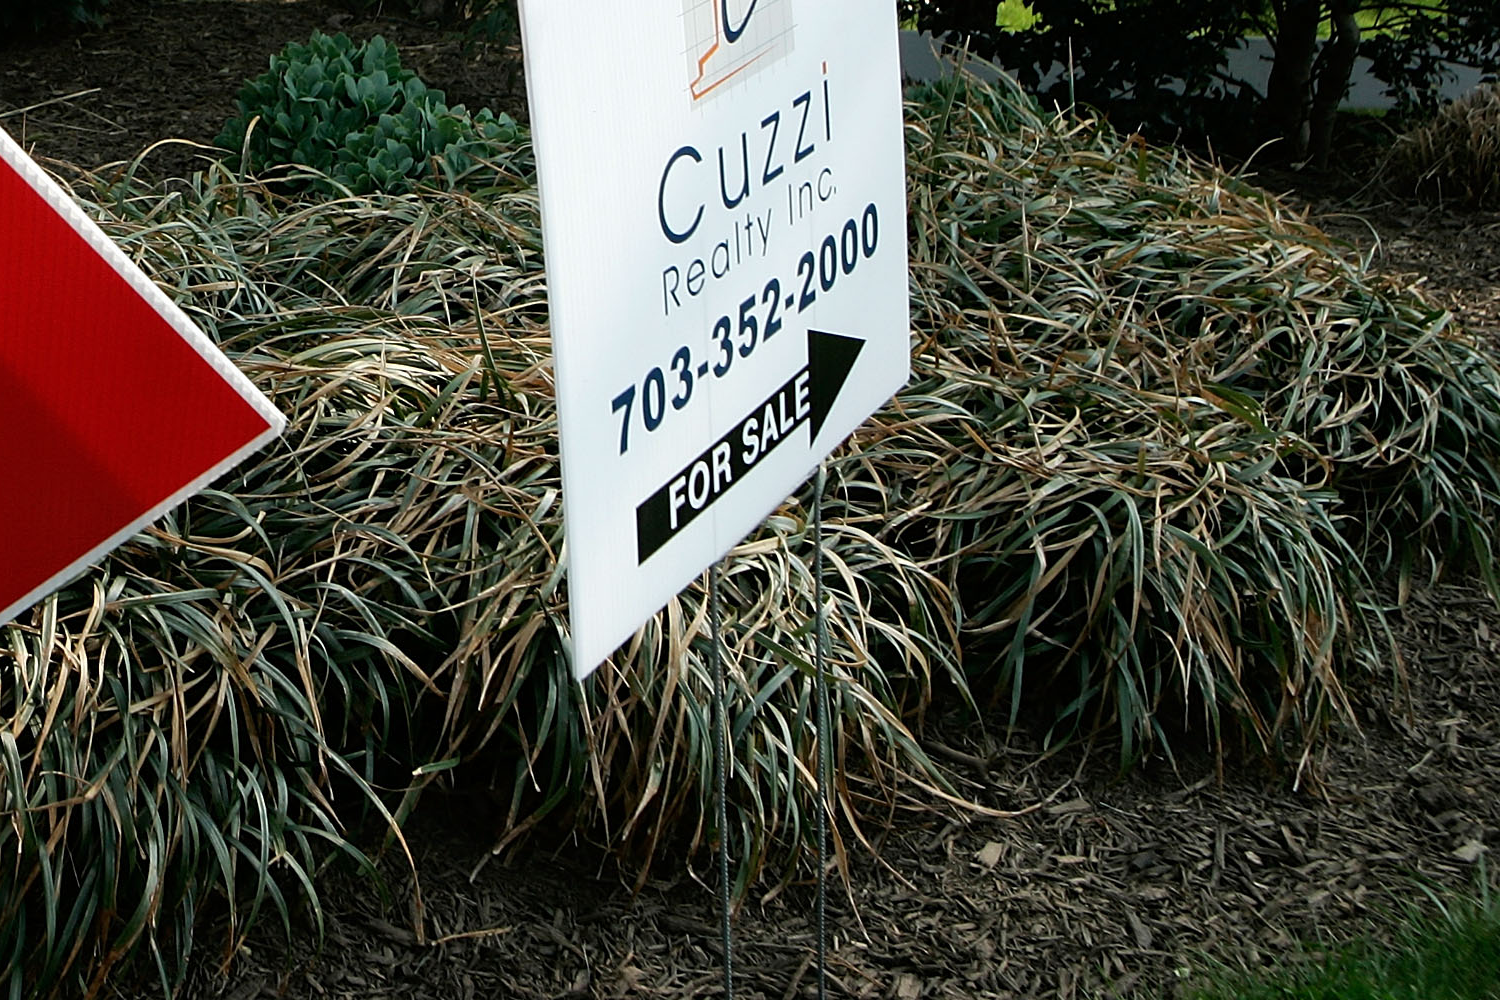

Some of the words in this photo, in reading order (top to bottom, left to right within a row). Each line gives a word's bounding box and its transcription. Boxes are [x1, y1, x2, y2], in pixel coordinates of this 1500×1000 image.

[657, 61, 833, 244] Cuzzi
[663, 208, 772, 316] Realty
[788, 166, 837, 226] Inc.
[611, 203, 879, 456] 703-352-2000
[668, 441, 733, 531] FOR
[742, 370, 812, 461] SALE
